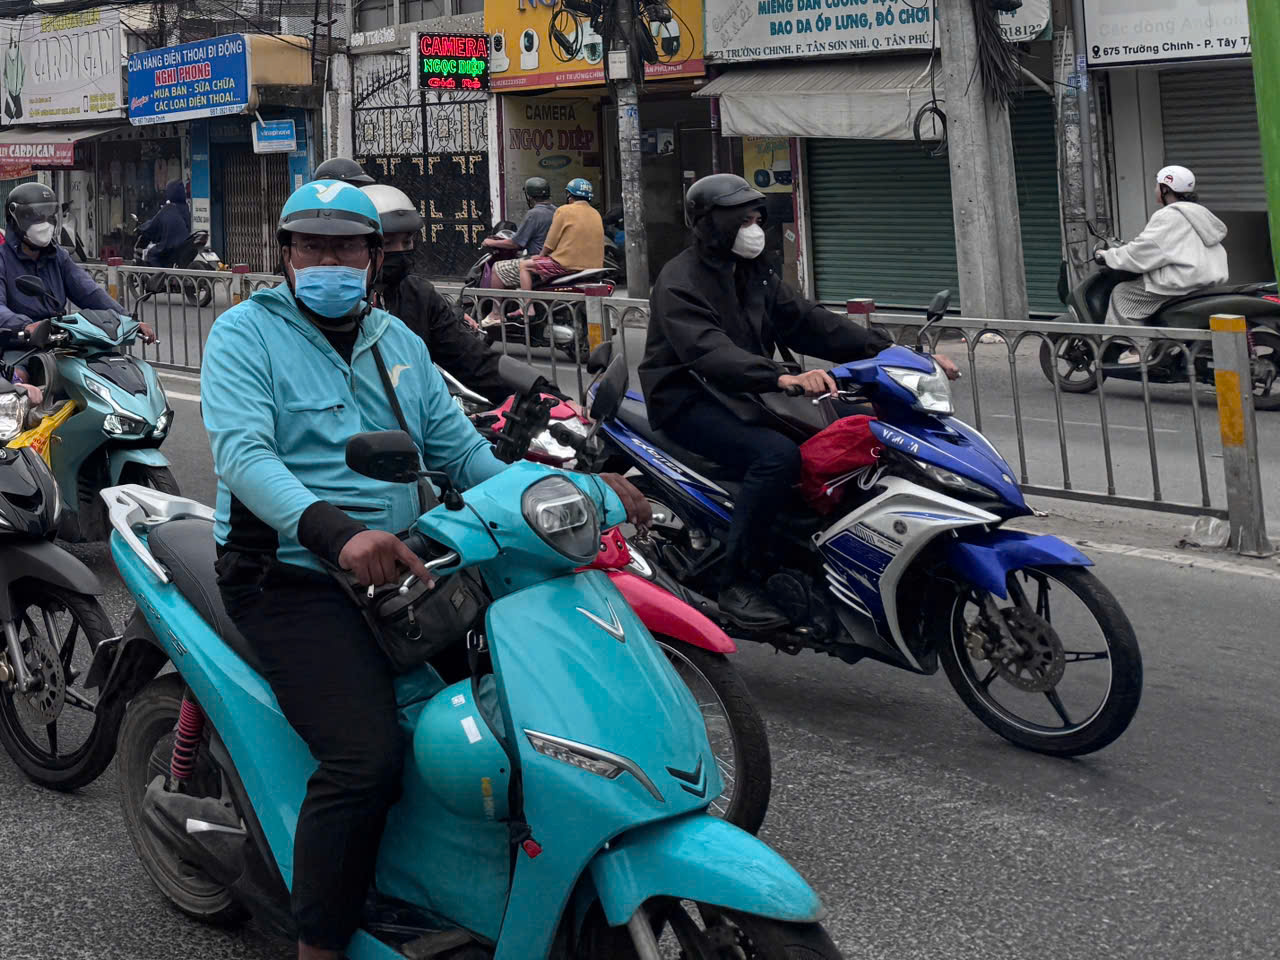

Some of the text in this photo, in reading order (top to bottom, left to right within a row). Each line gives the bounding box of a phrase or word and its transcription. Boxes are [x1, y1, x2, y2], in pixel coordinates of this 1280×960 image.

[770, 20, 793, 36] BAO
[796, 19, 813, 34] DA
[835, 12, 873, 30] LƯNG,
[898, 7, 930, 25] CHƠI
[128, 39, 243, 73] CỬA HÀNG ĐIỆN THOẠI ĐI ĐỘNG
[420, 35, 488, 58] CAMERA
[726, 44, 761, 59] TRƯỜNG
[807, 40, 826, 53] TÂN
[828, 38, 849, 52] SƠN
[884, 33, 907, 47] TÂN
[1103, 45, 1121, 57] 675
[1122, 42, 1160, 56] Trường
[1216, 37, 1238, 51] Tây
[155, 60, 212, 87] NGHI PHONG
[424, 58, 457, 77] NGỌC
[154, 87, 170, 100] MUA
[154, 97, 170, 113] CÁC
[188, 92, 208, 108] ĐIỆN
[525, 103, 577, 121] CAMERA
[8, 143, 55, 158] CARDIGAN
[509, 126, 554, 156] NGỌC
